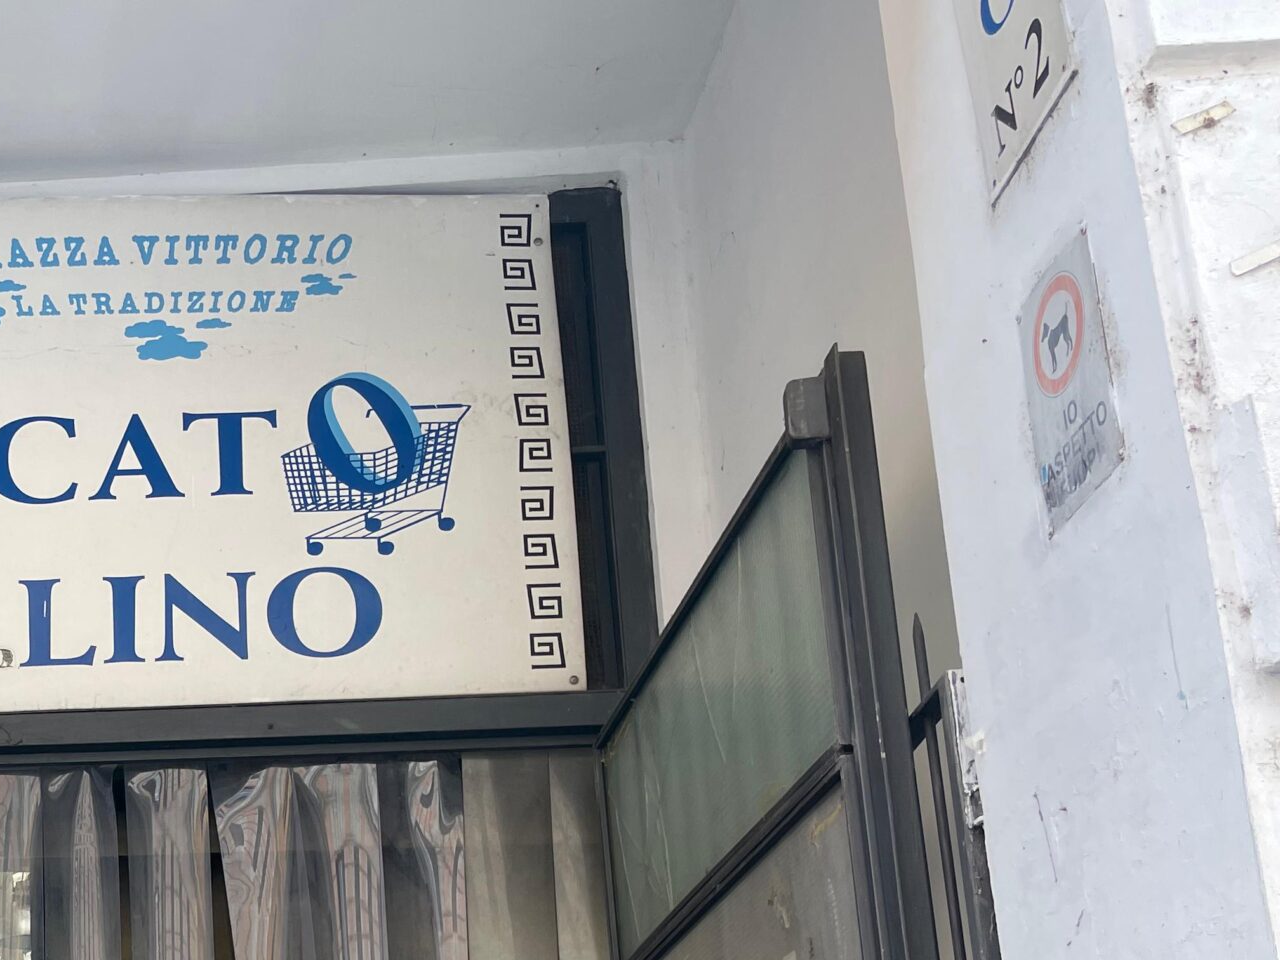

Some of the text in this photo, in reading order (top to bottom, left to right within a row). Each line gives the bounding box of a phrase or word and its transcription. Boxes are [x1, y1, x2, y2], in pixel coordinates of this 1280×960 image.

[132, 233, 352, 265] VITTORIO
[11, 290, 300, 317] LA TRADIZIONE
[1047, 401, 1107, 487] ASPETTO
